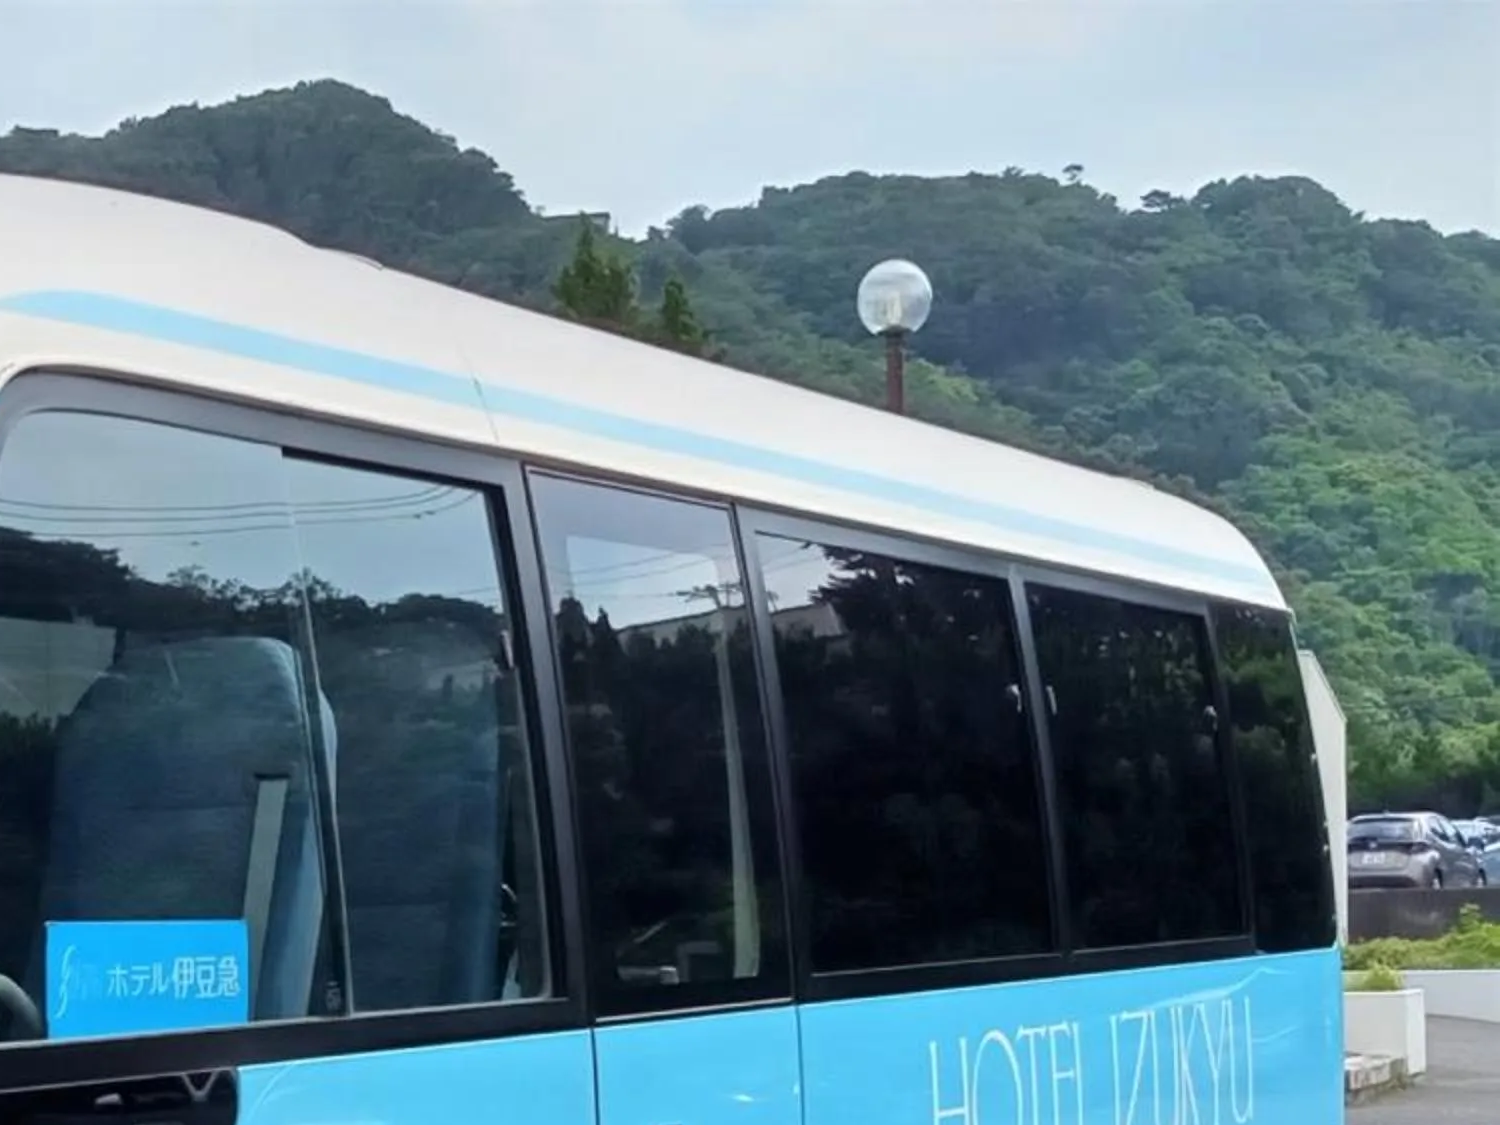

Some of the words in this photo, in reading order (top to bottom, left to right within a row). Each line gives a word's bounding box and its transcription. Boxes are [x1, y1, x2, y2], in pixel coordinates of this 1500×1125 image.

[106, 954, 241, 999] ホテル伊豆急
